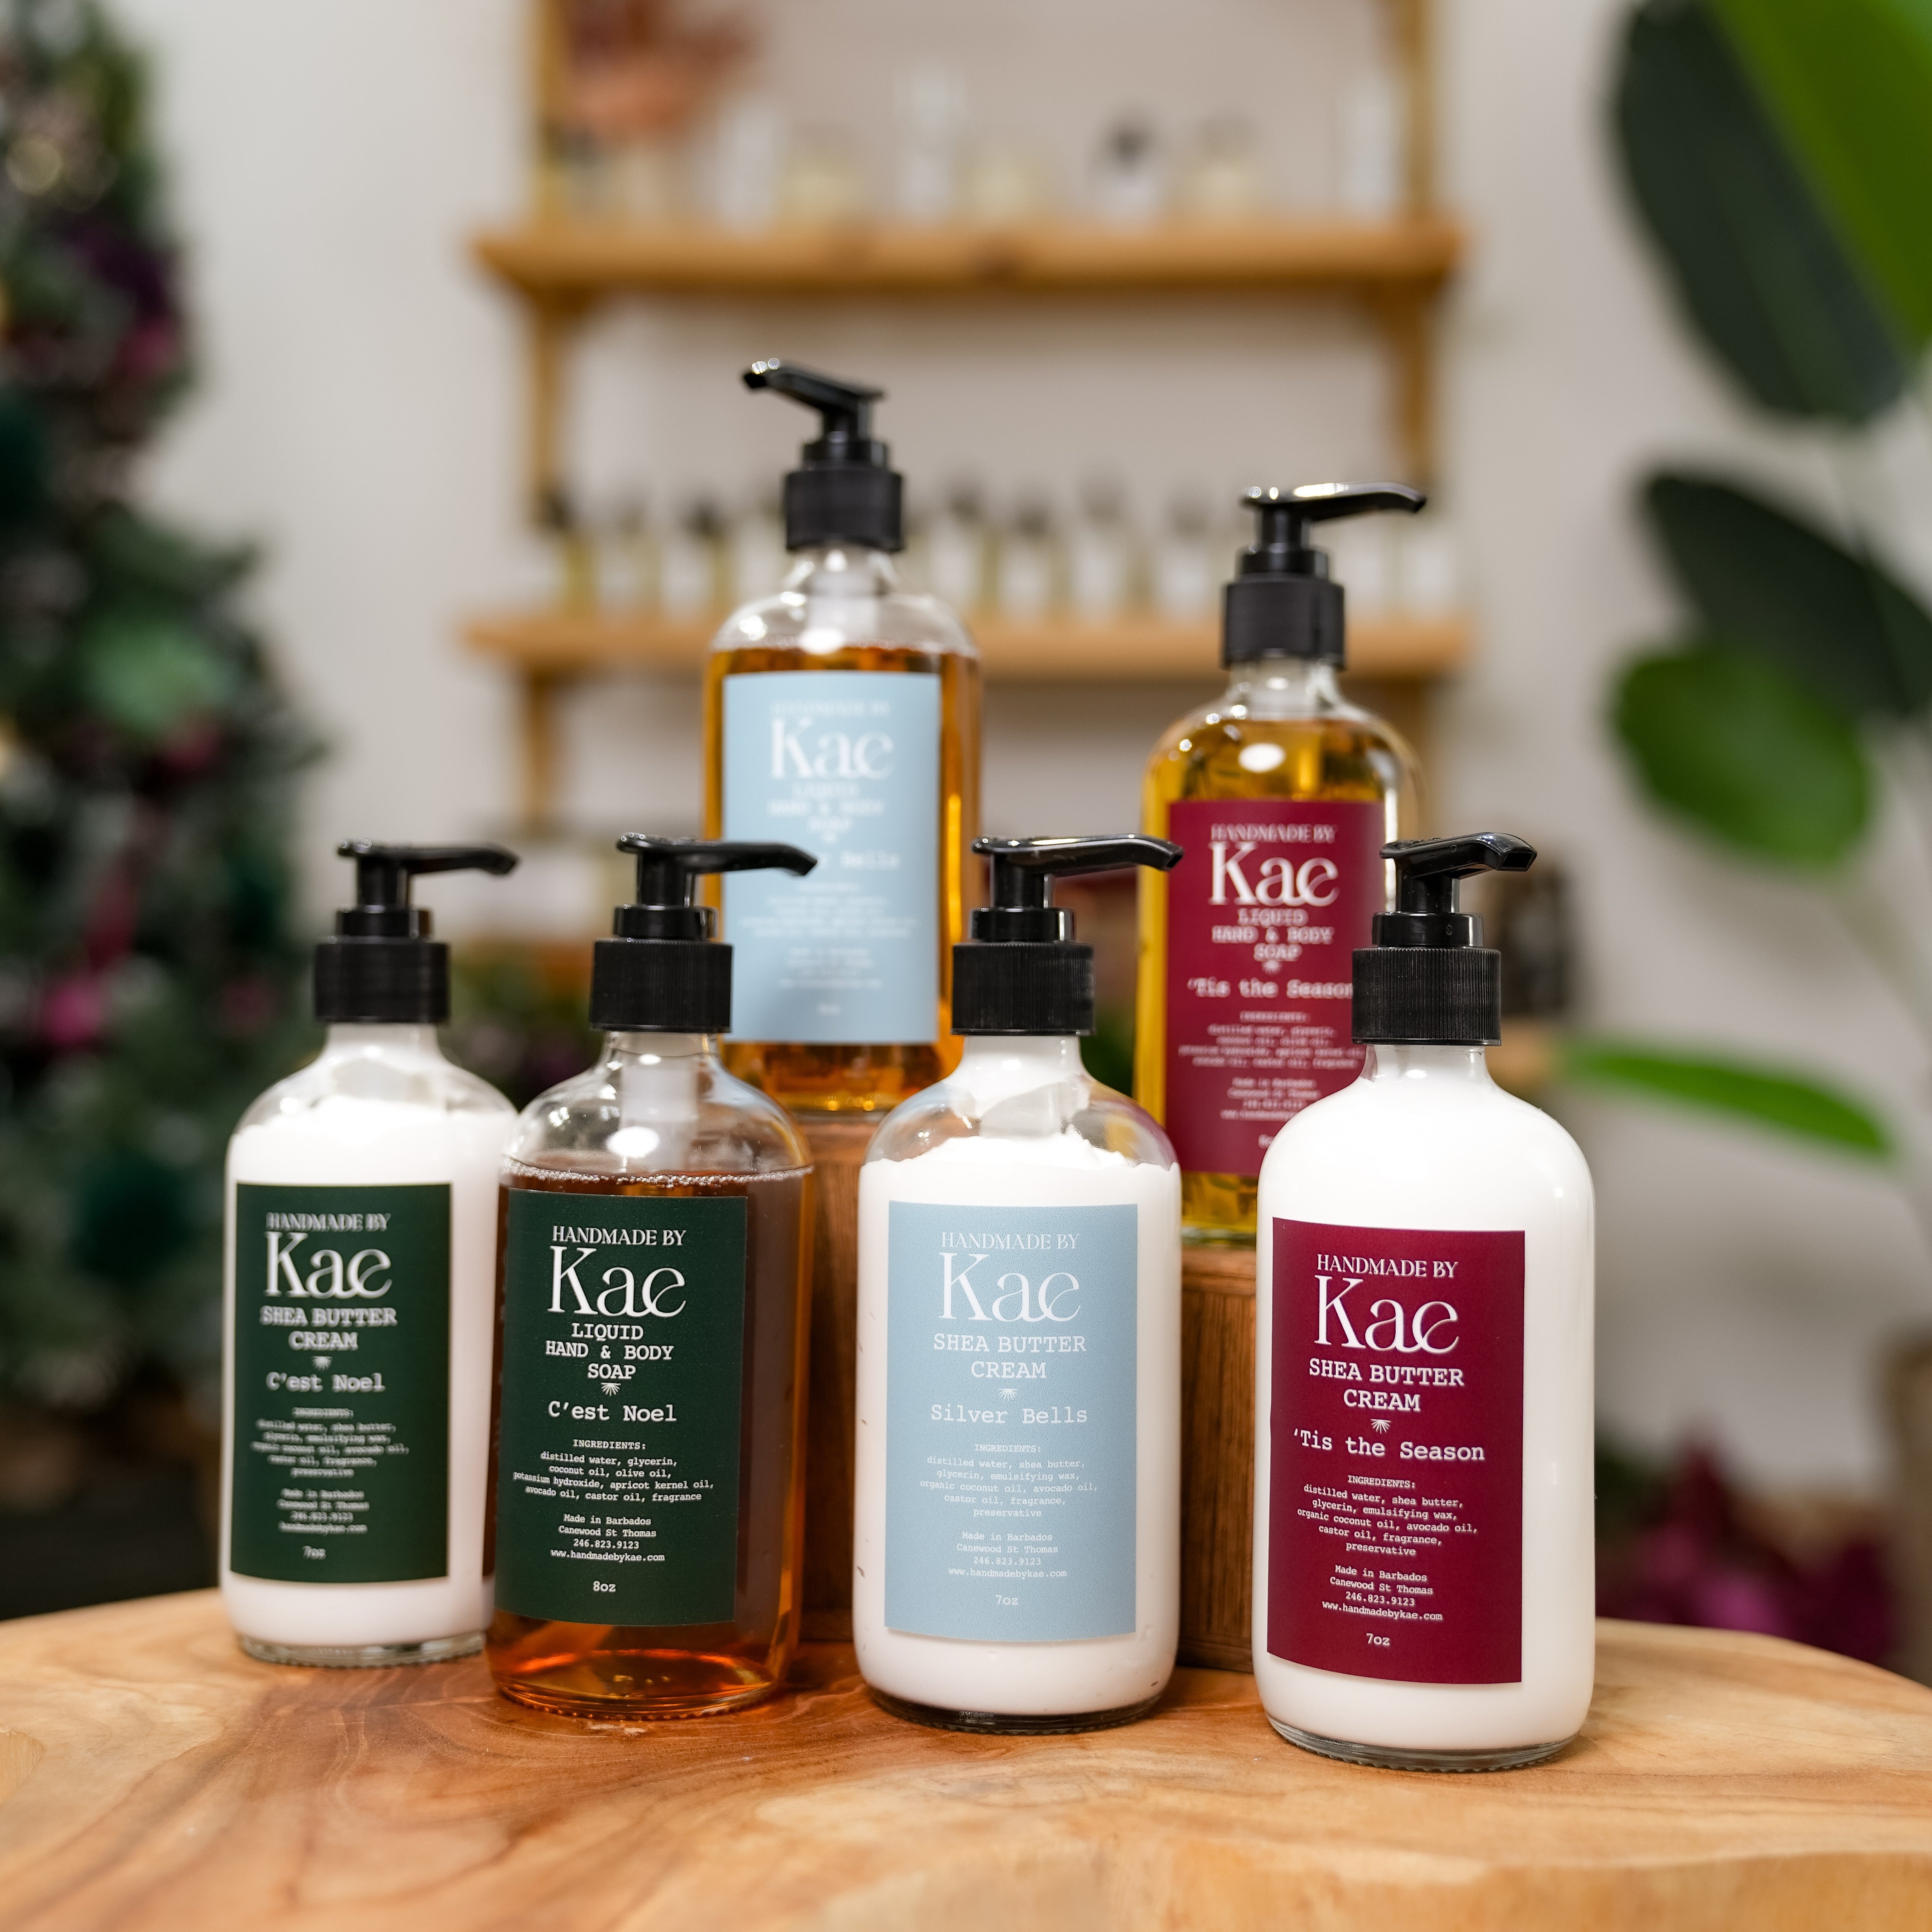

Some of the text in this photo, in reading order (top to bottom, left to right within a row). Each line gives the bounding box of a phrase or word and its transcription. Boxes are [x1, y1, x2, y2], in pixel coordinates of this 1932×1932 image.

[769, 716, 895, 780] Kae
[1211, 824, 1338, 844] HANDMADE BY
[1208, 841, 1340, 907] Kae
[1212, 925, 1258, 944] HAND
[1287, 926, 1335, 944] BODY
[1239, 978, 1279, 998] the
[268, 1213, 390, 1231] HANDMADE BY
[552, 1226, 686, 1246] HANDMADE BY
[942, 1232, 1080, 1250] HANDMADE BY
[267, 1232, 391, 1298] Kae
[1317, 1254, 1459, 1278] HANDMADE BY
[547, 1246, 686, 1317] Kae
[938, 1253, 1081, 1322] Kae
[261, 1306, 397, 1326] SHEA BUTTER
[1314, 1275, 1459, 1354] Kae
[289, 1331, 358, 1350] CREAM
[571, 1323, 644, 1341] LIQUID
[545, 1341, 674, 1360] HAND & BODY
[934, 1333, 1086, 1353] SHEA BUTTER
[588, 1364, 636, 1380] SOAP
[971, 1361, 1046, 1379] CREAM
[1309, 1358, 1464, 1386] SHEA BUTTER
[333, 1373, 385, 1392] Noel
[1344, 1389, 1421, 1411] CREAM
[623, 1405, 677, 1422] Noel
[931, 1404, 1087, 1424] Silver Bells
[573, 1439, 646, 1450] INGREDIENTS:
[1345, 1437, 1386, 1456] the
[1400, 1442, 1485, 1461] Season
[540, 1452, 677, 1467] distilled water, glycerin,
[927, 1456, 974, 1467] distilled
[979, 1460, 1012, 1469] water,
[1047, 1460, 1085, 1468] butter,
[513, 1472, 714, 1490] potassium hydroxide, apricot kernel oil,
[549, 1466, 584, 1475] coconut
[588, 1468, 610, 1477] oil,
[649, 1469, 672, 1478] oil,
[937, 1470, 984, 1480] glycerin,
[990, 1473, 1054, 1481] emulsifying
[920, 1480, 955, 1490] organic
[960, 1484, 999, 1492] coconut
[1005, 1485, 1027, 1493] oil,
[1077, 1482, 1098, 1491] oil,
[1348, 1475, 1416, 1489] INGREDIENTS:
[525, 1485, 556, 1496] avocado
[560, 1490, 580, 1499] oil,
[623, 1493, 646, 1502] oil,
[652, 1493, 702, 1502] fragrance
[944, 1495, 1066, 1505] castor oil, fragrance,
[1304, 1484, 1463, 1508] distilled water, shea butter,
[973, 1509, 1043, 1517] preservative
[1313, 1499, 1457, 1521] glycerin, emulsifying wax,
[564, 1514, 651, 1525] Made in Barbados
[1297, 1509, 1478, 1533] organic coconut oil, avocado oil,
[559, 1526, 601, 1535] Canewood
[962, 1532, 985, 1540] Made
[991, 1532, 1002, 1540] in
[1319, 1526, 1442, 1545] castor oil, fragrance,
[573, 1538, 640, 1549] 246.823.9123
[956, 1543, 1002, 1553] Canewood
[1346, 1542, 1416, 1556] preservative
[550, 1549, 665, 1562] www.handmadebykae.com
[973, 1557, 1042, 1566] 246.823.9123
[948, 1568, 1067, 1579] www.handmadebykae.com
[1335, 1565, 1427, 1581] Made in Barbados
[593, 1581, 617, 1592] 8oz
[1330, 1577, 1433, 1595] Canewood St Thomas
[995, 1595, 1019, 1606] 7oz
[1346, 1592, 1415, 1607] 246.823.9123
[1322, 1601, 1443, 1621] www.handmadebykae.com
[1366, 1633, 1390, 1646] 7oz
